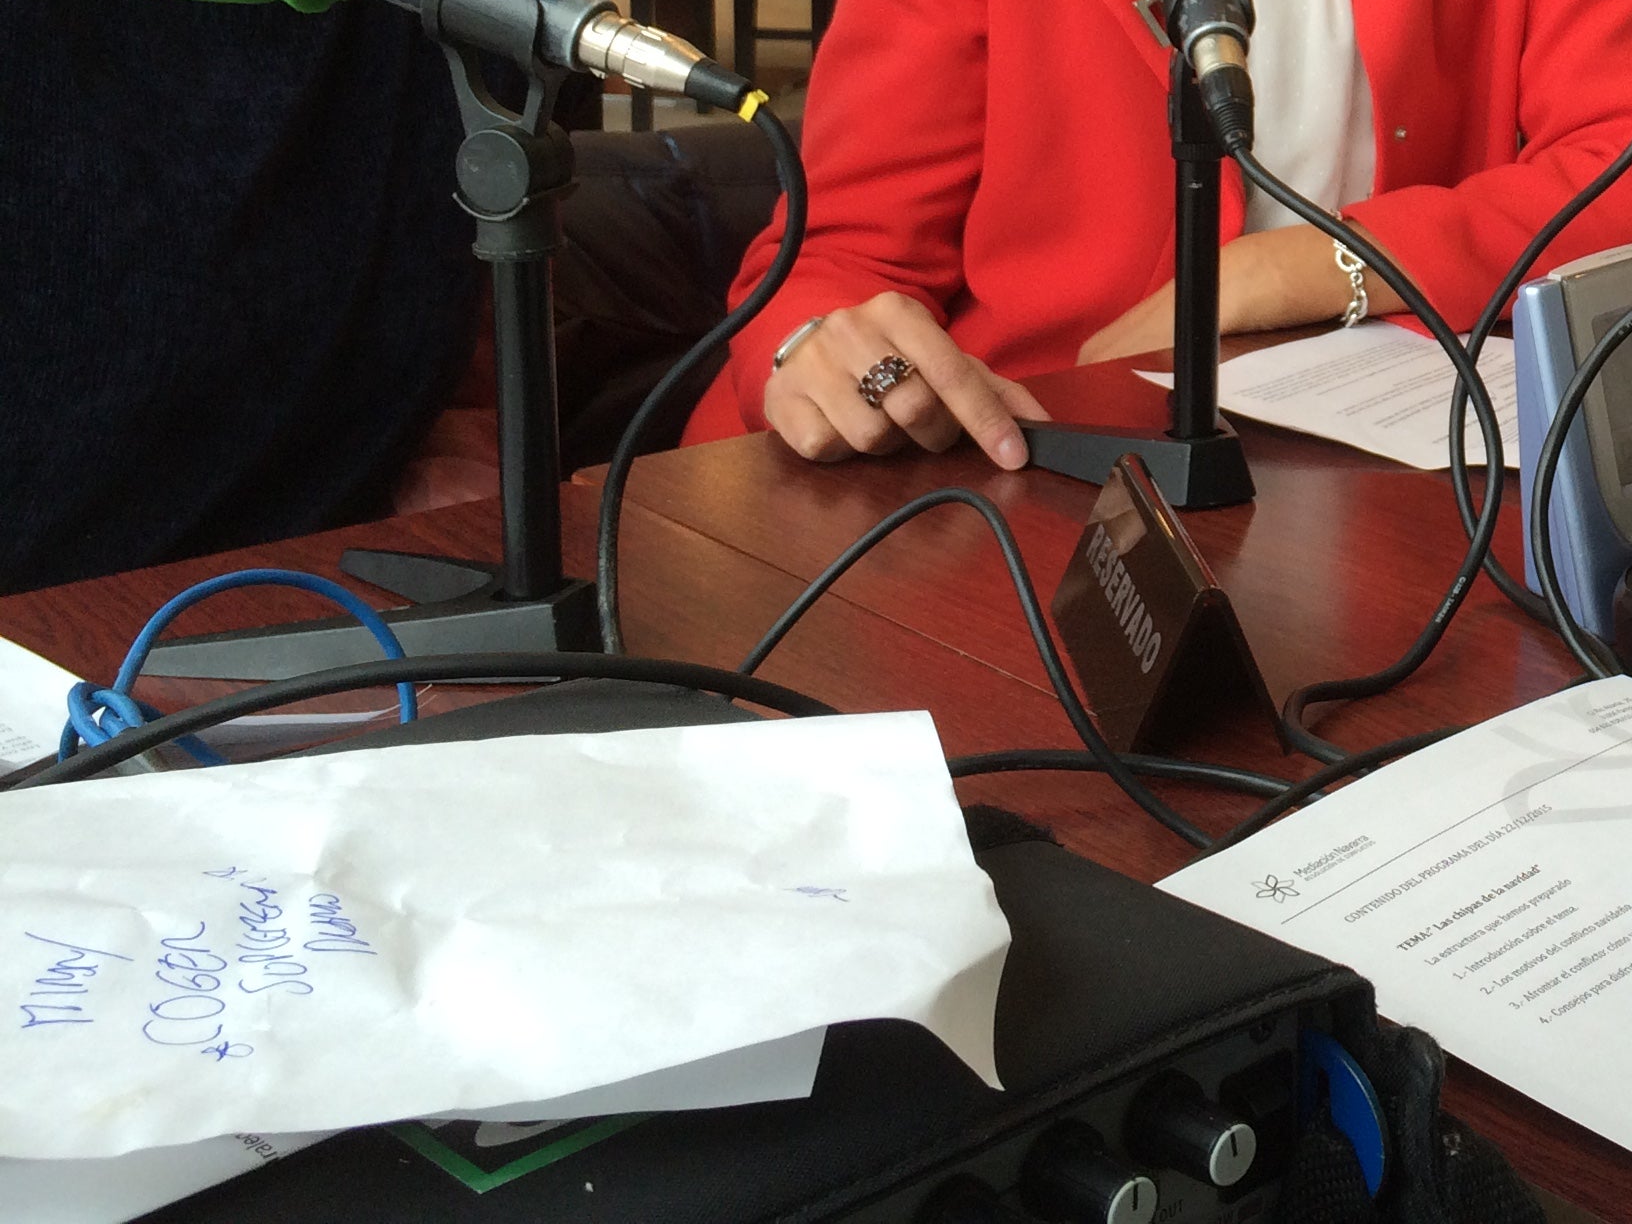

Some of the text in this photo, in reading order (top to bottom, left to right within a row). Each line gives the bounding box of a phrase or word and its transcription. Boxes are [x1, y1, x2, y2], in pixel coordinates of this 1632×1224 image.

[1086, 524, 1161, 674] RESERVADO
[1292, 835, 1369, 877] Mediación Navarra
[1343, 888, 1403, 924] CONTENIDO
[1399, 878, 1422, 891] DEL
[1418, 849, 1472, 879] PROGRAMA
[1468, 840, 1489, 851] DEL
[1501, 804, 1552, 833] 22/12/2015
[1423, 880, 1571, 967] La estructura que hemos preparado
[1432, 918, 1454, 931] Las
[1452, 901, 1483, 920] chipas
[1480, 892, 1497, 903] de
[1490, 887, 1507, 896] la
[1465, 938, 1524, 972] Introducción
[1522, 924, 1547, 939] sobre
[1544, 916, 1558, 926] el
[1492, 975, 1513, 987] Los
[1512, 954, 1548, 977] motivos
[1545, 944, 1562, 955] del
[1560, 926, 1596, 947] conflicto
[1523, 977, 1562, 1001] Afrontar
[1560, 969, 1573, 980] el
[1551, 992, 1592, 1016] Consejos
[1590, 980, 1612, 995] para
